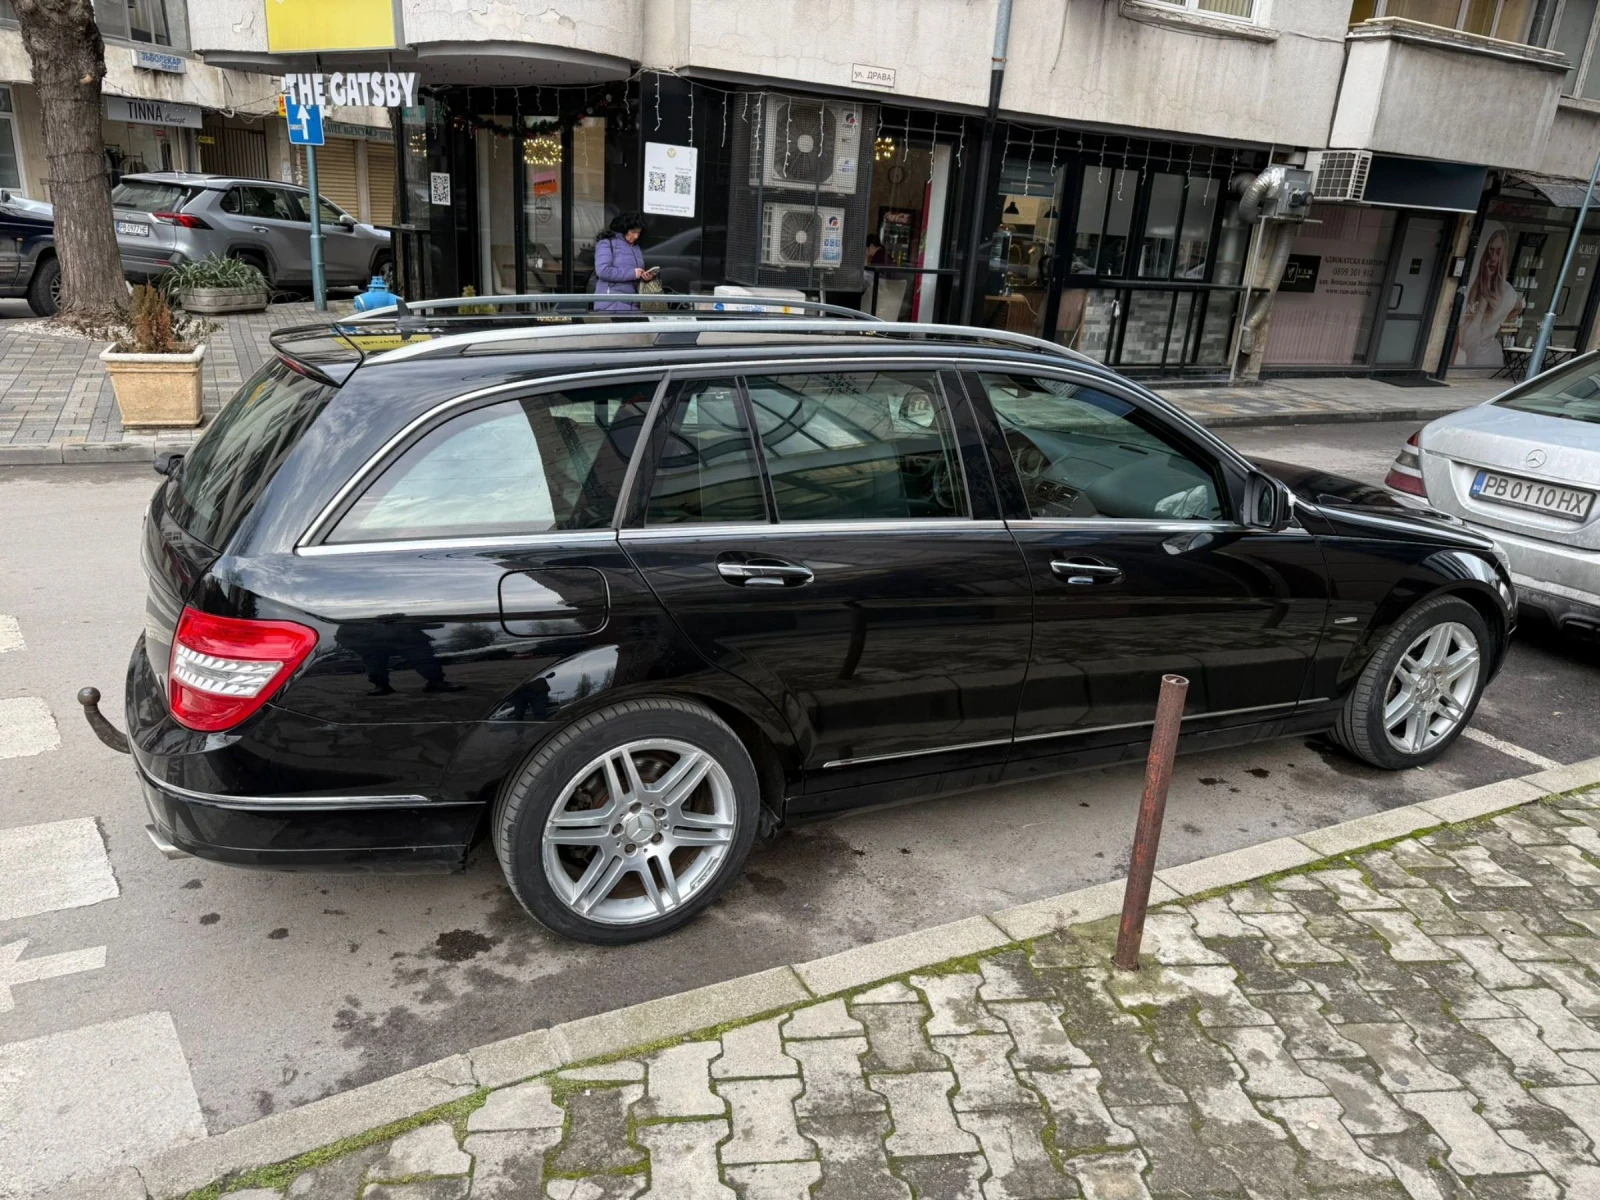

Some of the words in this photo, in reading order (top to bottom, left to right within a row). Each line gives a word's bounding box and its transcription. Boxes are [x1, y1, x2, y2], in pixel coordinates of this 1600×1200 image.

[867, 71, 892, 81] ДРАВА
[285, 73, 325, 105] THE
[330, 72, 415, 107] GATSBY
[126, 101, 163, 122] TINNA
[164, 113, 186, 124] Concept
